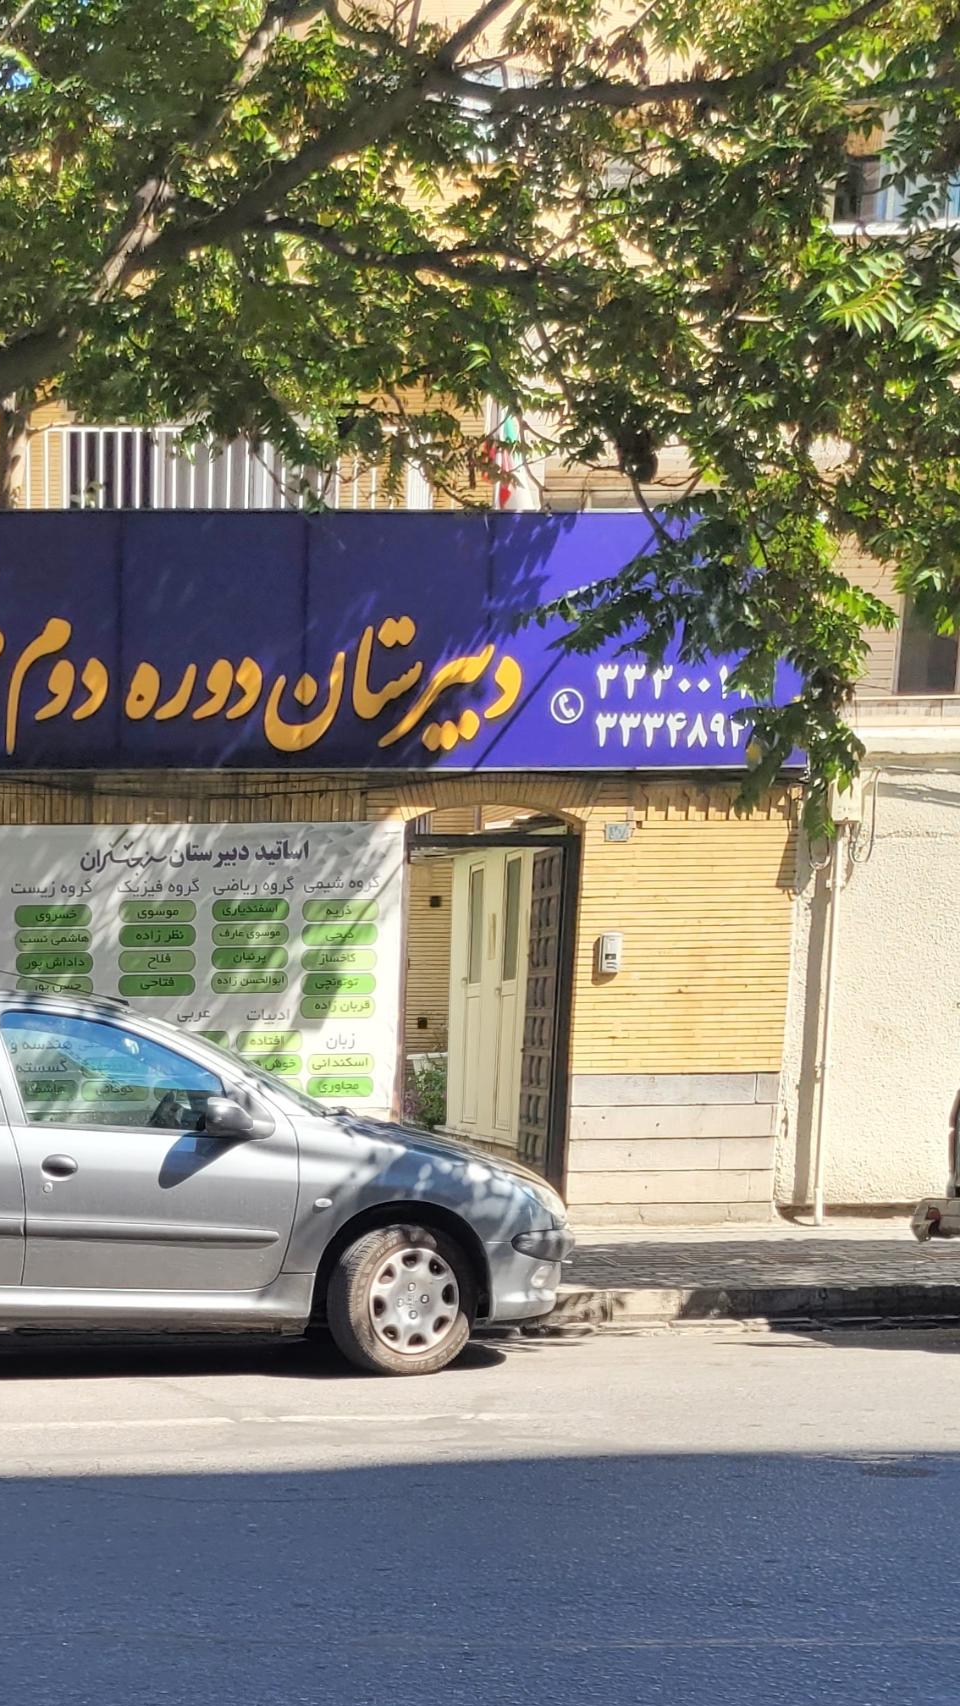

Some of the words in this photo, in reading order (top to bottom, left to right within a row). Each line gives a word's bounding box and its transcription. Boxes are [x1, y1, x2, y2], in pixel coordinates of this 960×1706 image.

[5, 616, 109, 755] دوم
[125, 656, 263, 720] دوره
[264, 616, 523, 752] دبیرستان
[169, 841, 249, 868] دبیرستان
[255, 840, 309, 865] اساتید
[10, 881, 55, 897] زیست
[60, 880, 92, 897] گروه
[117, 880, 163, 897] فیزیک
[168, 880, 200, 897] گروه
[213, 879, 258, 895] ریاضی
[263, 876, 295, 895] گروه
[304, 876, 344, 894] شیمی
[349, 876, 381, 894] گروه
[35, 912, 77, 923] خسروی
[137, 909, 179, 920] موسوی
[222, 904, 278, 917] اسفندیاری
[20, 936, 48, 946] نسب
[51, 934, 89, 945] هاشمی
[136, 931, 162, 943] زاده
[165, 931, 184, 943] نظر
[247, 930, 281, 940] موسوی
[24, 959, 43, 971] پور
[46, 957, 85, 970] داداش
[147, 953, 171, 970] فلاح
[140, 977, 175, 990] فتاحی
[217, 977, 238, 988] زاده
[240, 976, 285, 987] ابوالحسن
[315, 1001, 337, 1012] زاده
[340, 1001, 370, 1012] قربان
[177, 1008, 210, 1023] عربی
[246, 1008, 290, 1025] ادبیات
[326, 1033, 355, 1050] زبان
[319, 1080, 360, 1093] مجاوری
